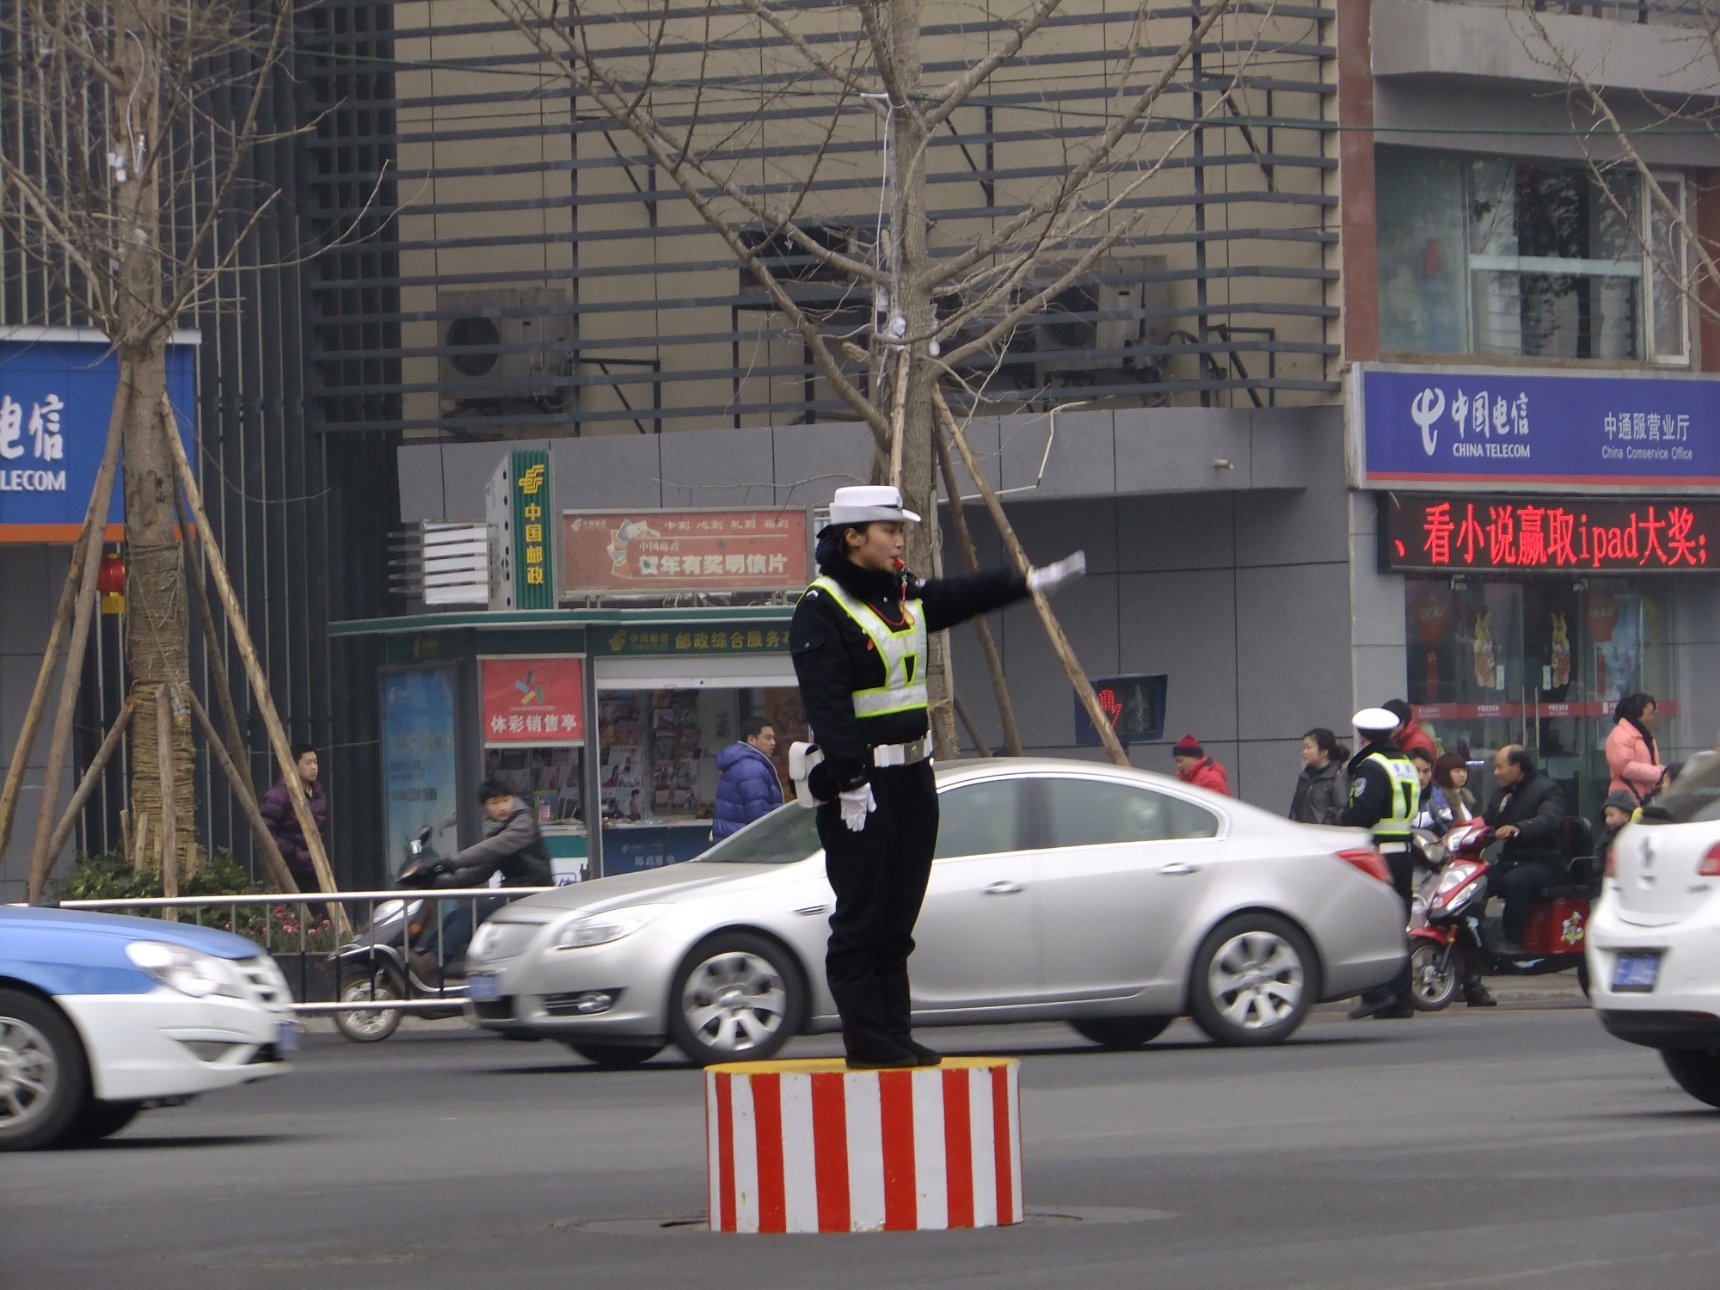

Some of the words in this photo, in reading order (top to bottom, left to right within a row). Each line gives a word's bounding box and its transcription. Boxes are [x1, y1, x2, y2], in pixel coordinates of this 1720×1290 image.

[1451, 388, 1530, 439] 中国电信
[1603, 411, 1691, 441] 中通服营业厅
[1452, 442, 1484, 458] CHINA
[1485, 443, 1531, 458] TELECOM
[1602, 445, 1624, 459] China
[1626, 446, 1669, 459] Comservice
[1671, 446, 1693, 460] Office
[696, 520, 723, 530] 心到
[524, 503, 544, 585] 中国邮政
[639, 553, 788, 576] 贺年有奖明信片
[490, 713, 577, 734] 体彩销售亭
